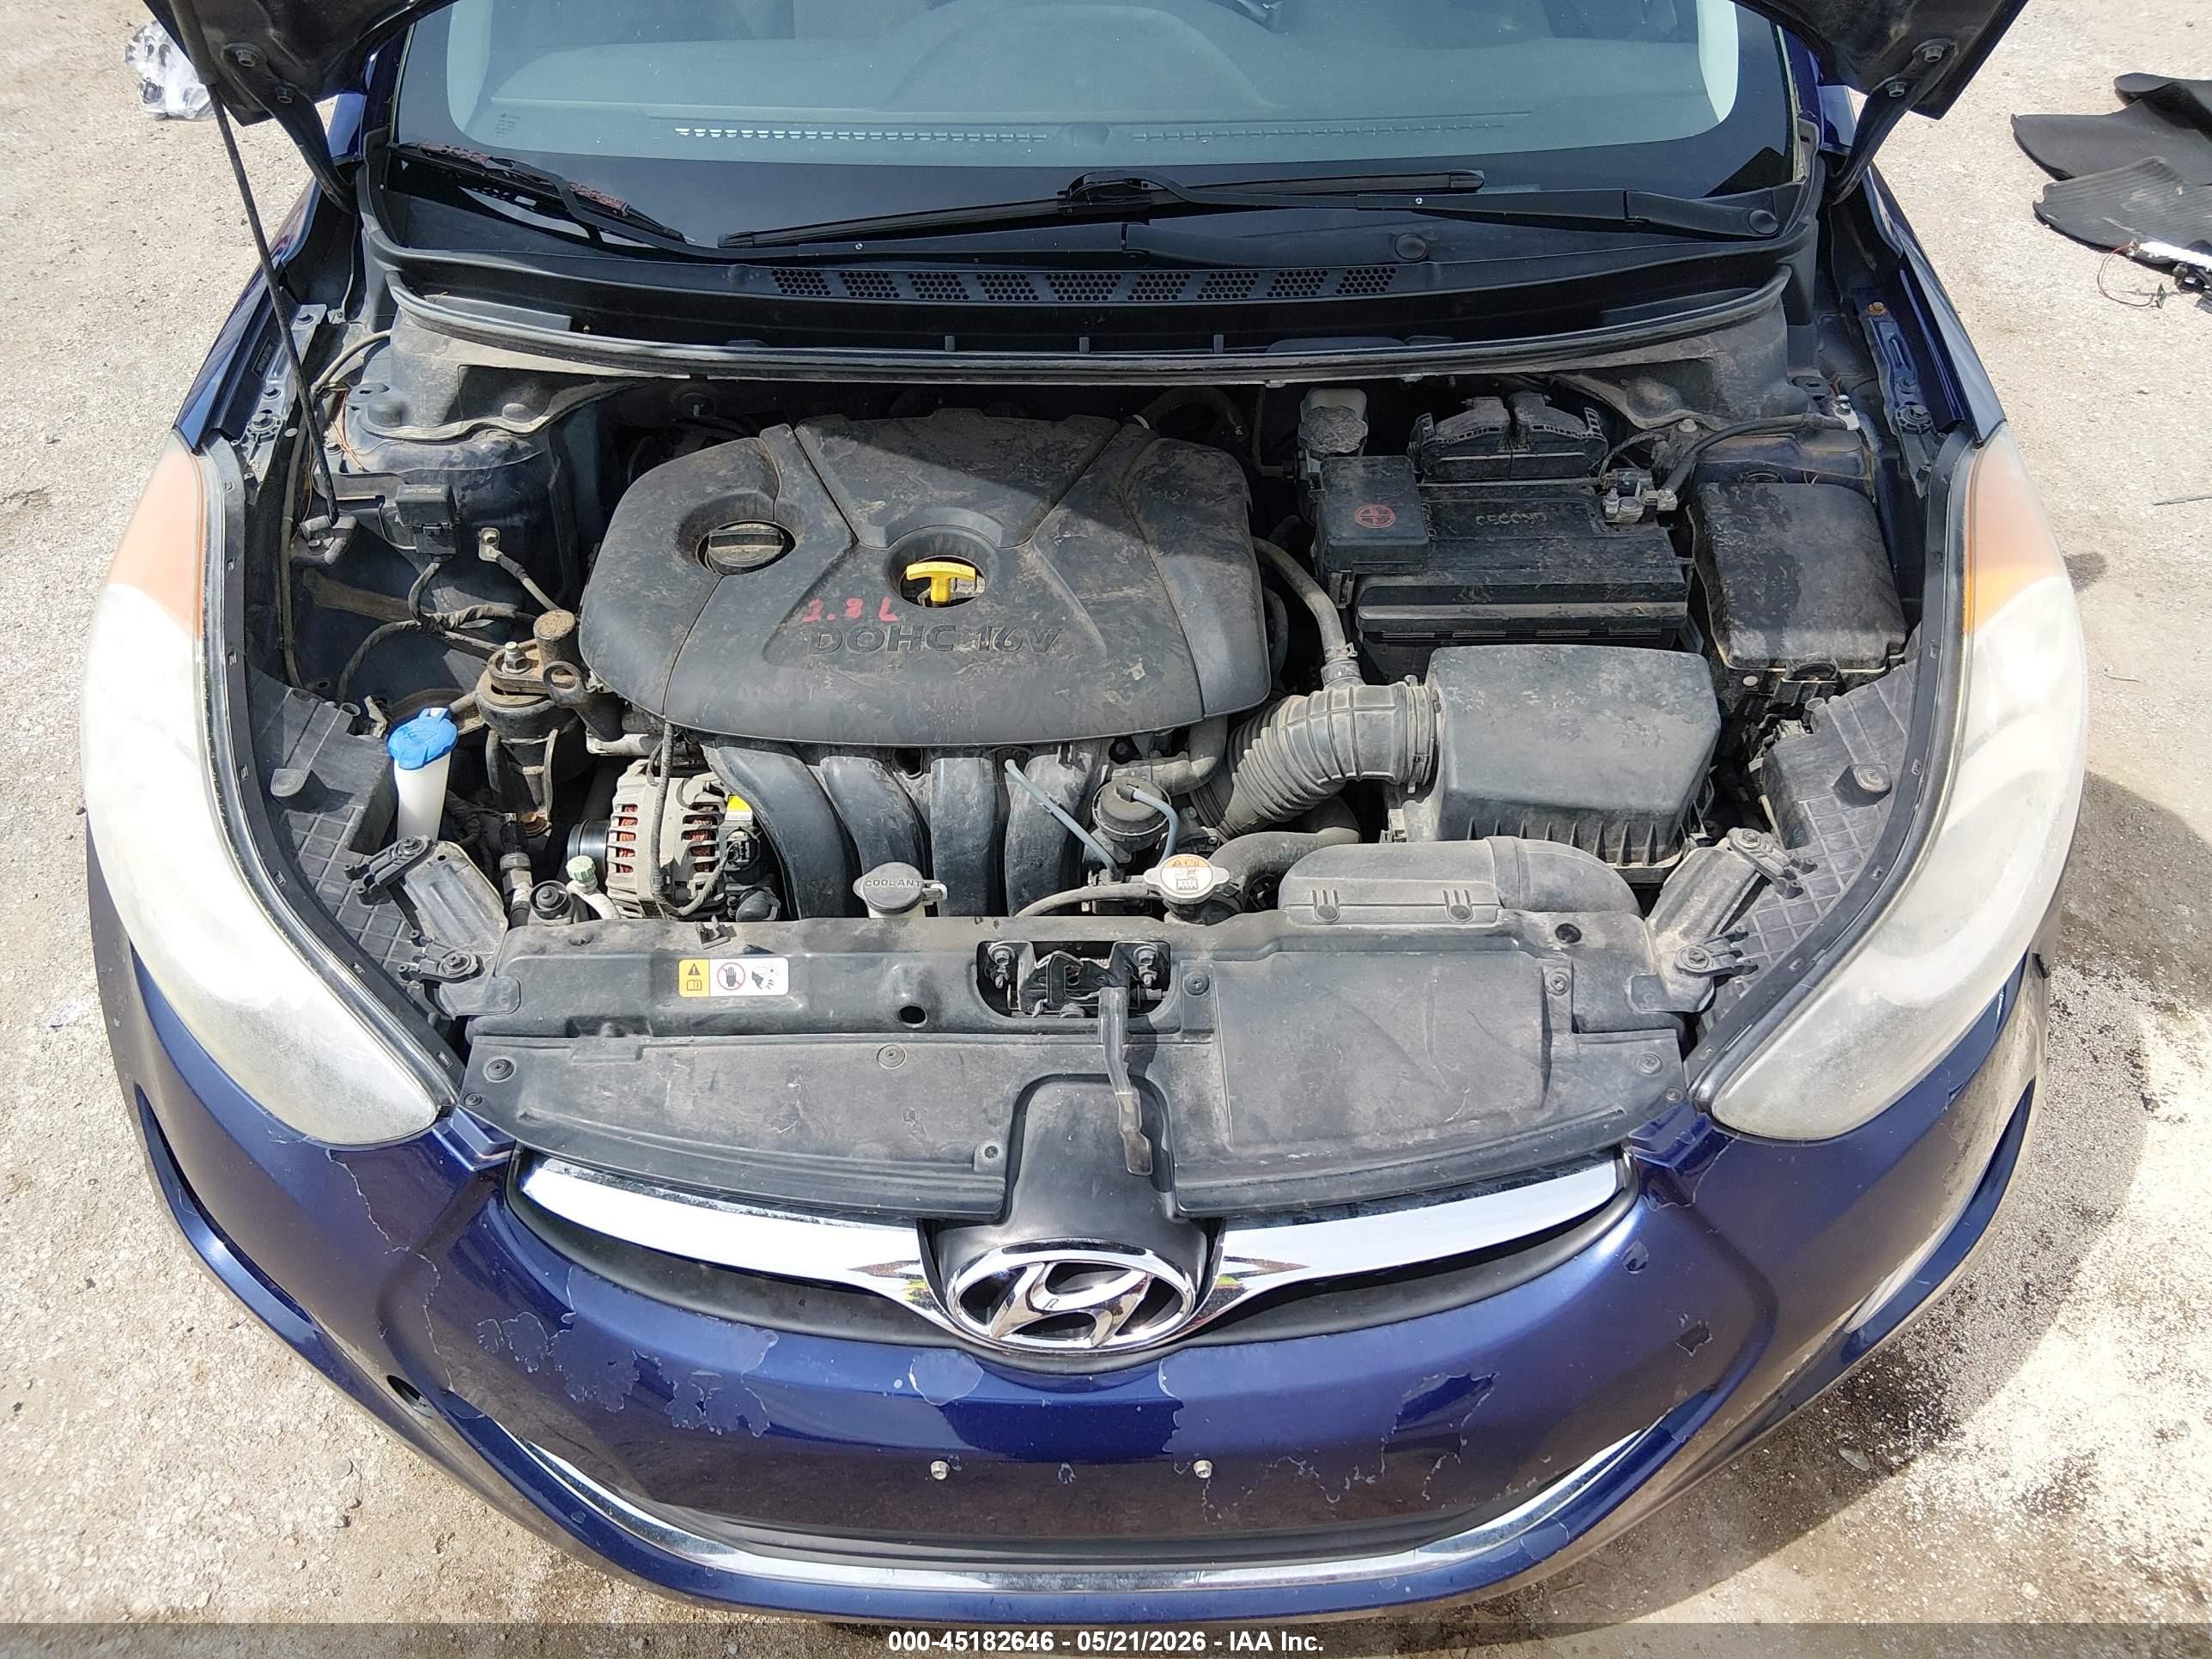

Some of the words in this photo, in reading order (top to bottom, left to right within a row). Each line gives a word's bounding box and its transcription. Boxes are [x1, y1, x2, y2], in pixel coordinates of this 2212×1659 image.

[810, 624, 957, 655] DOHC
[976, 625, 1063, 654] 16V
[865, 878, 922, 888] COOLANT
